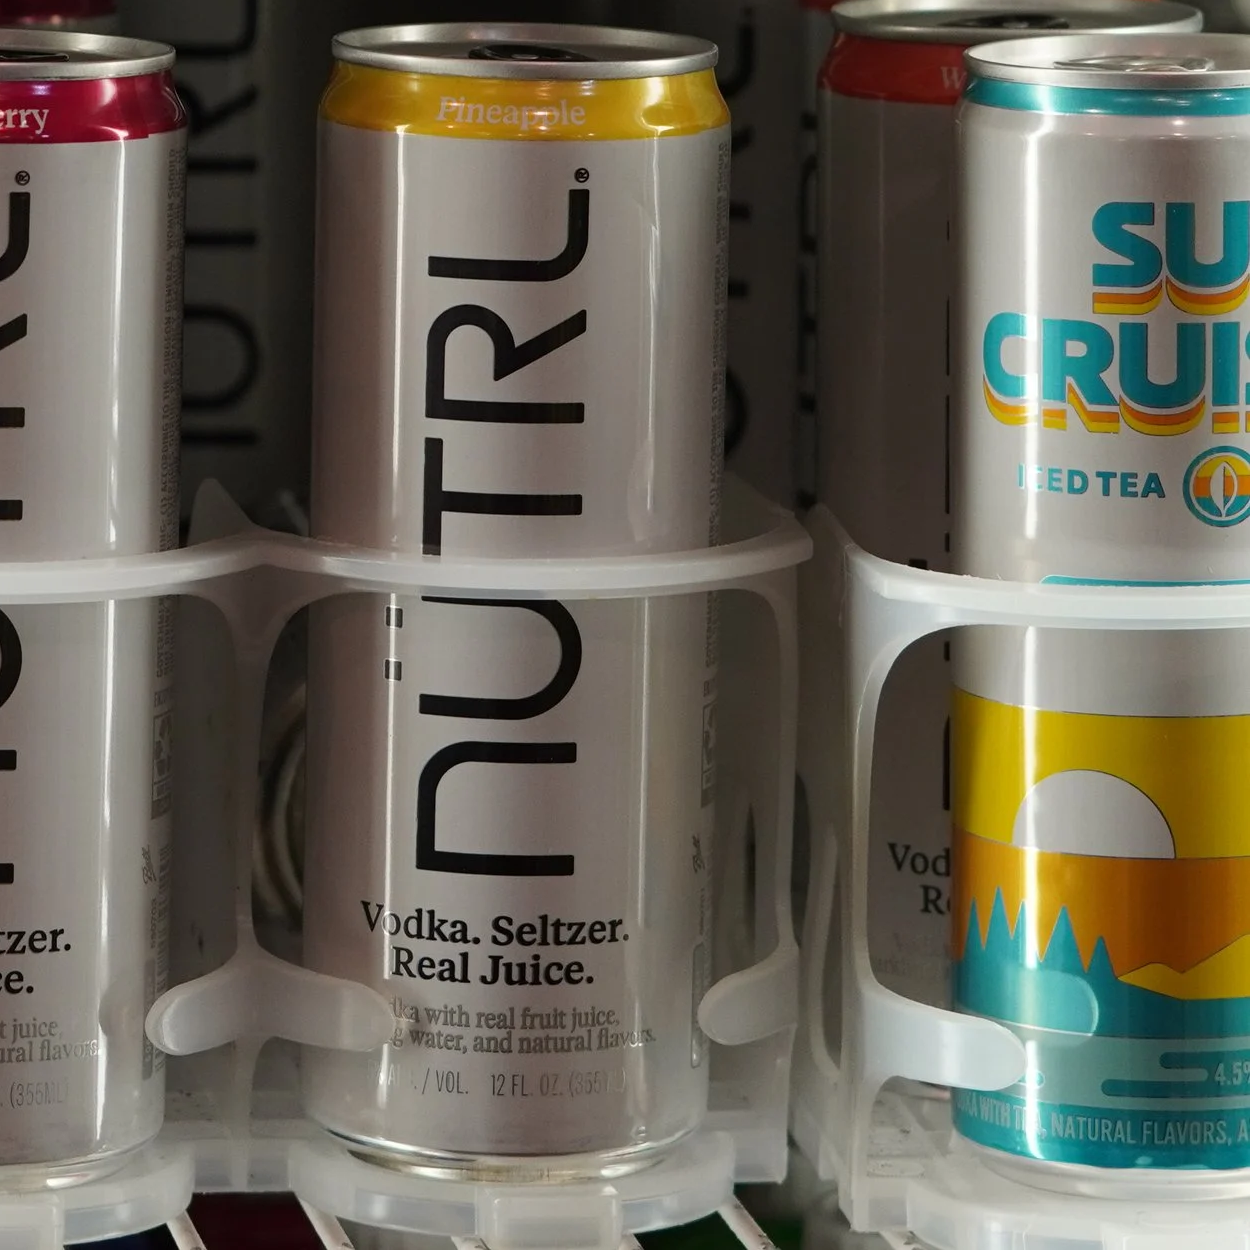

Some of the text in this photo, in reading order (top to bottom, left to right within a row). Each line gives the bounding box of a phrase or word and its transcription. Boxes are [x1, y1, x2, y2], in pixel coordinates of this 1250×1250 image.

[434, 96, 587, 130] Pineapple
[1017, 462, 1166, 499] ICED TEA
[360, 899, 630, 947] Vodka. Seltzer.
[390, 946, 595, 987] Real Juice.
[424, 1004, 470, 1029] with
[475, 1006, 515, 1030] real
[519, 1007, 567, 1030] fruit
[570, 1006, 620, 1032] juice,
[408, 1029, 468, 1055] water,
[472, 1030, 512, 1054] and
[517, 1029, 592, 1055] natural
[1051, 1115, 1232, 1148] NATURAL FLAVORS,
